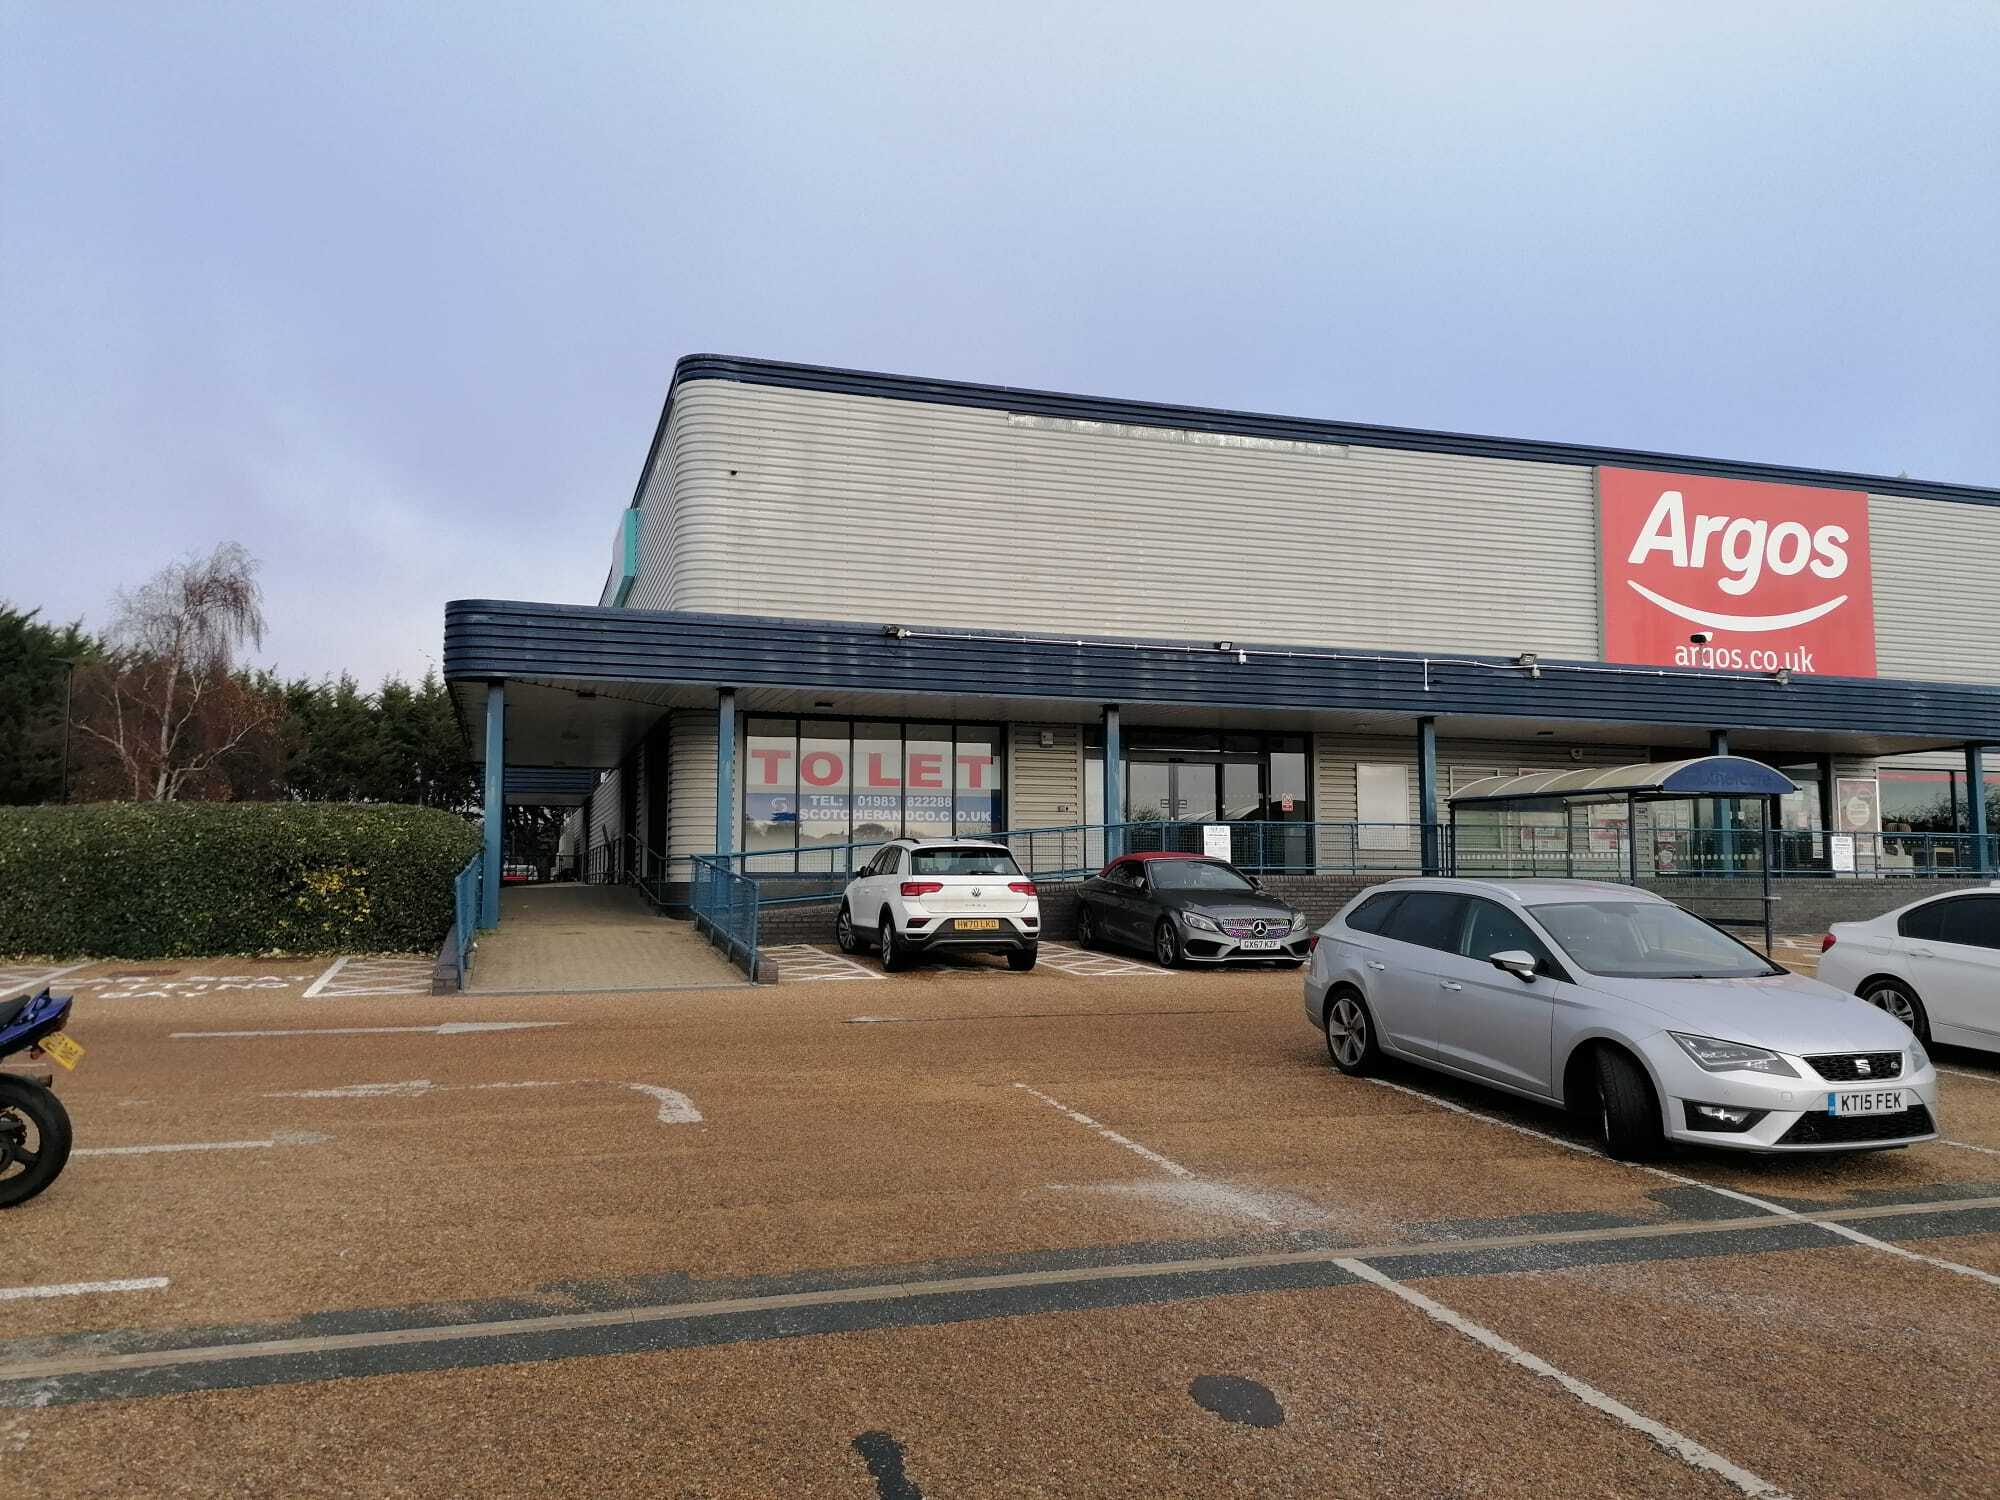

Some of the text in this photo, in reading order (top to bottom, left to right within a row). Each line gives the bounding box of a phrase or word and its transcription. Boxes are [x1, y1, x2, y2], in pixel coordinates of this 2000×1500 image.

[1627, 490, 1849, 595] Argos
[1675, 645, 1816, 672] argos.co.uk
[751, 749, 993, 788] TO LET
[810, 795, 952, 808] TEL: 01983 822288
[1841, 1092, 1902, 1112] KT15 FEK
